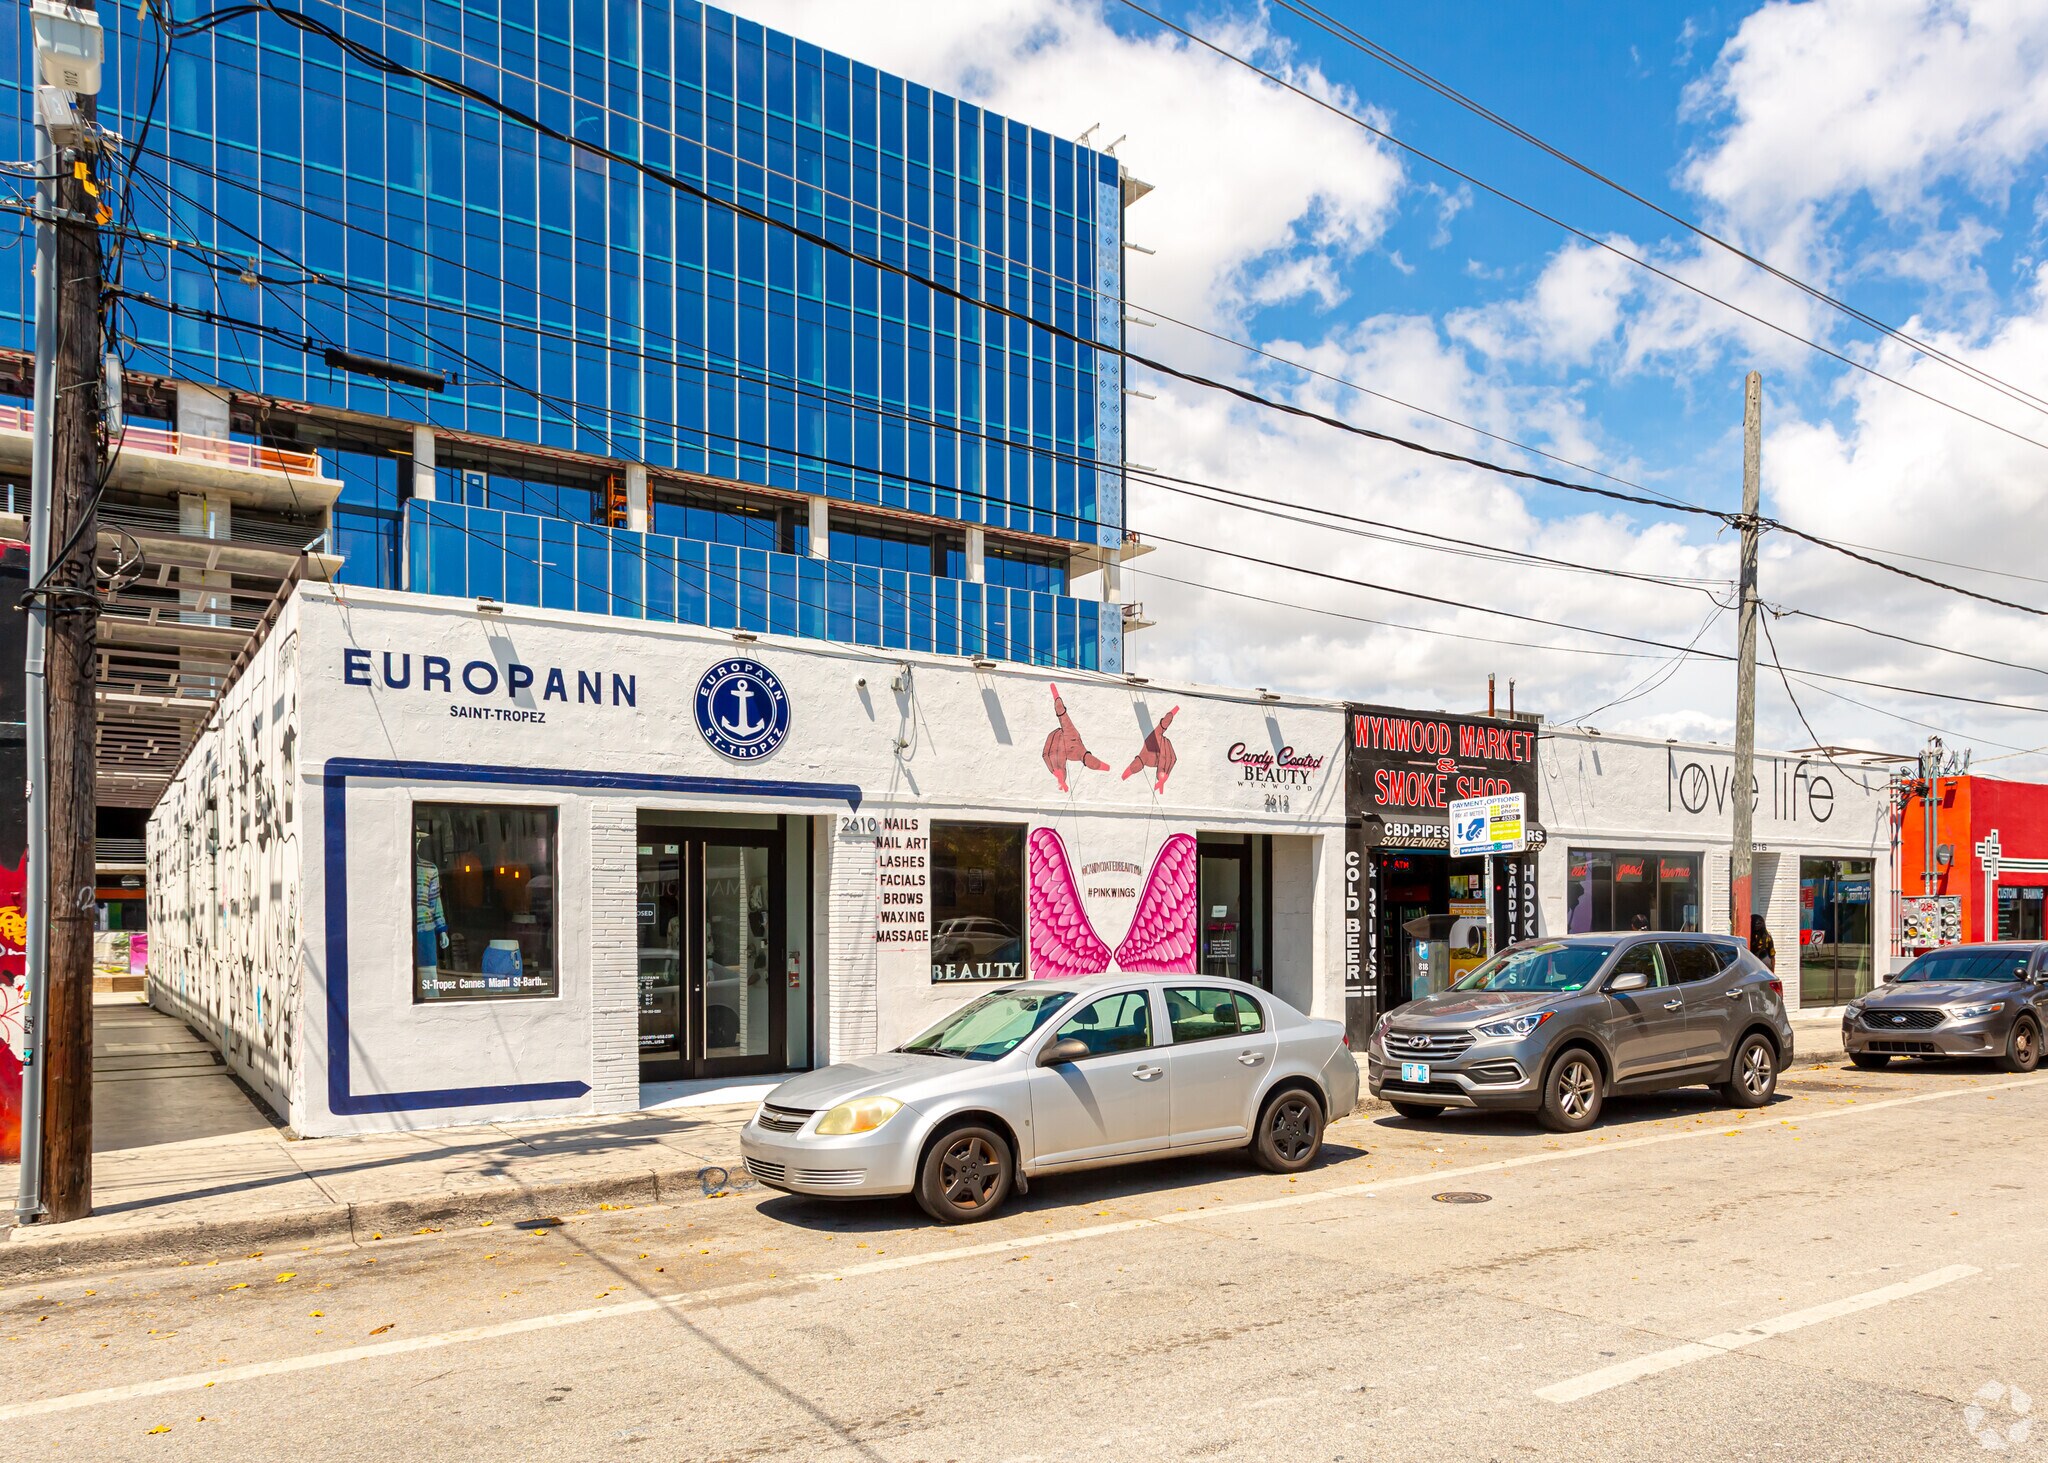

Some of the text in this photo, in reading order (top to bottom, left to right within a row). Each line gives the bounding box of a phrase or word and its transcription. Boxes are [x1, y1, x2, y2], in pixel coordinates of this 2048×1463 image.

[344, 648, 636, 707] EUROPANN
[700, 663, 784, 700] EUROPANN
[450, 705, 546, 723] SAINT-TROPEZ
[705, 727, 783, 757] ST-TROPEZ
[1354, 714, 1535, 763] WYNWOOD MARKET
[1227, 742, 1324, 772] Candy Coated
[1437, 757, 1459, 774] &
[1244, 765, 1311, 785] BEAUTY
[1237, 781, 1313, 792] WYNWOOD
[1374, 768, 1448, 808] SMOKE
[1774, 758, 1834, 823] life
[1452, 795, 1520, 809] PAYMENT OPTIONS
[841, 816, 877, 832] 2610
[884, 817, 919, 830] NAILS
[876, 836, 928, 849] NAIL ART
[1380, 836, 1450, 848] SOUVENIRS
[1752, 843, 1767, 851] 616
[880, 855, 925, 868] LASHES
[1615, 859, 1645, 883] good
[880, 874, 926, 886] FACIALS
[883, 892, 923, 905] BROWS
[1088, 887, 1136, 898] #PINKWINGS
[1998, 887, 2017, 899] CUSTOM
[881, 911, 925, 923] WAXING
[1345, 851, 1360, 980] COLD BEER
[876, 930, 929, 943] MASSAGE
[932, 963, 1020, 980] BEAUTY
[422, 979, 456, 991] St-Tropez
[459, 978, 485, 989] Cannes
[488, 977, 510, 988] Miami
